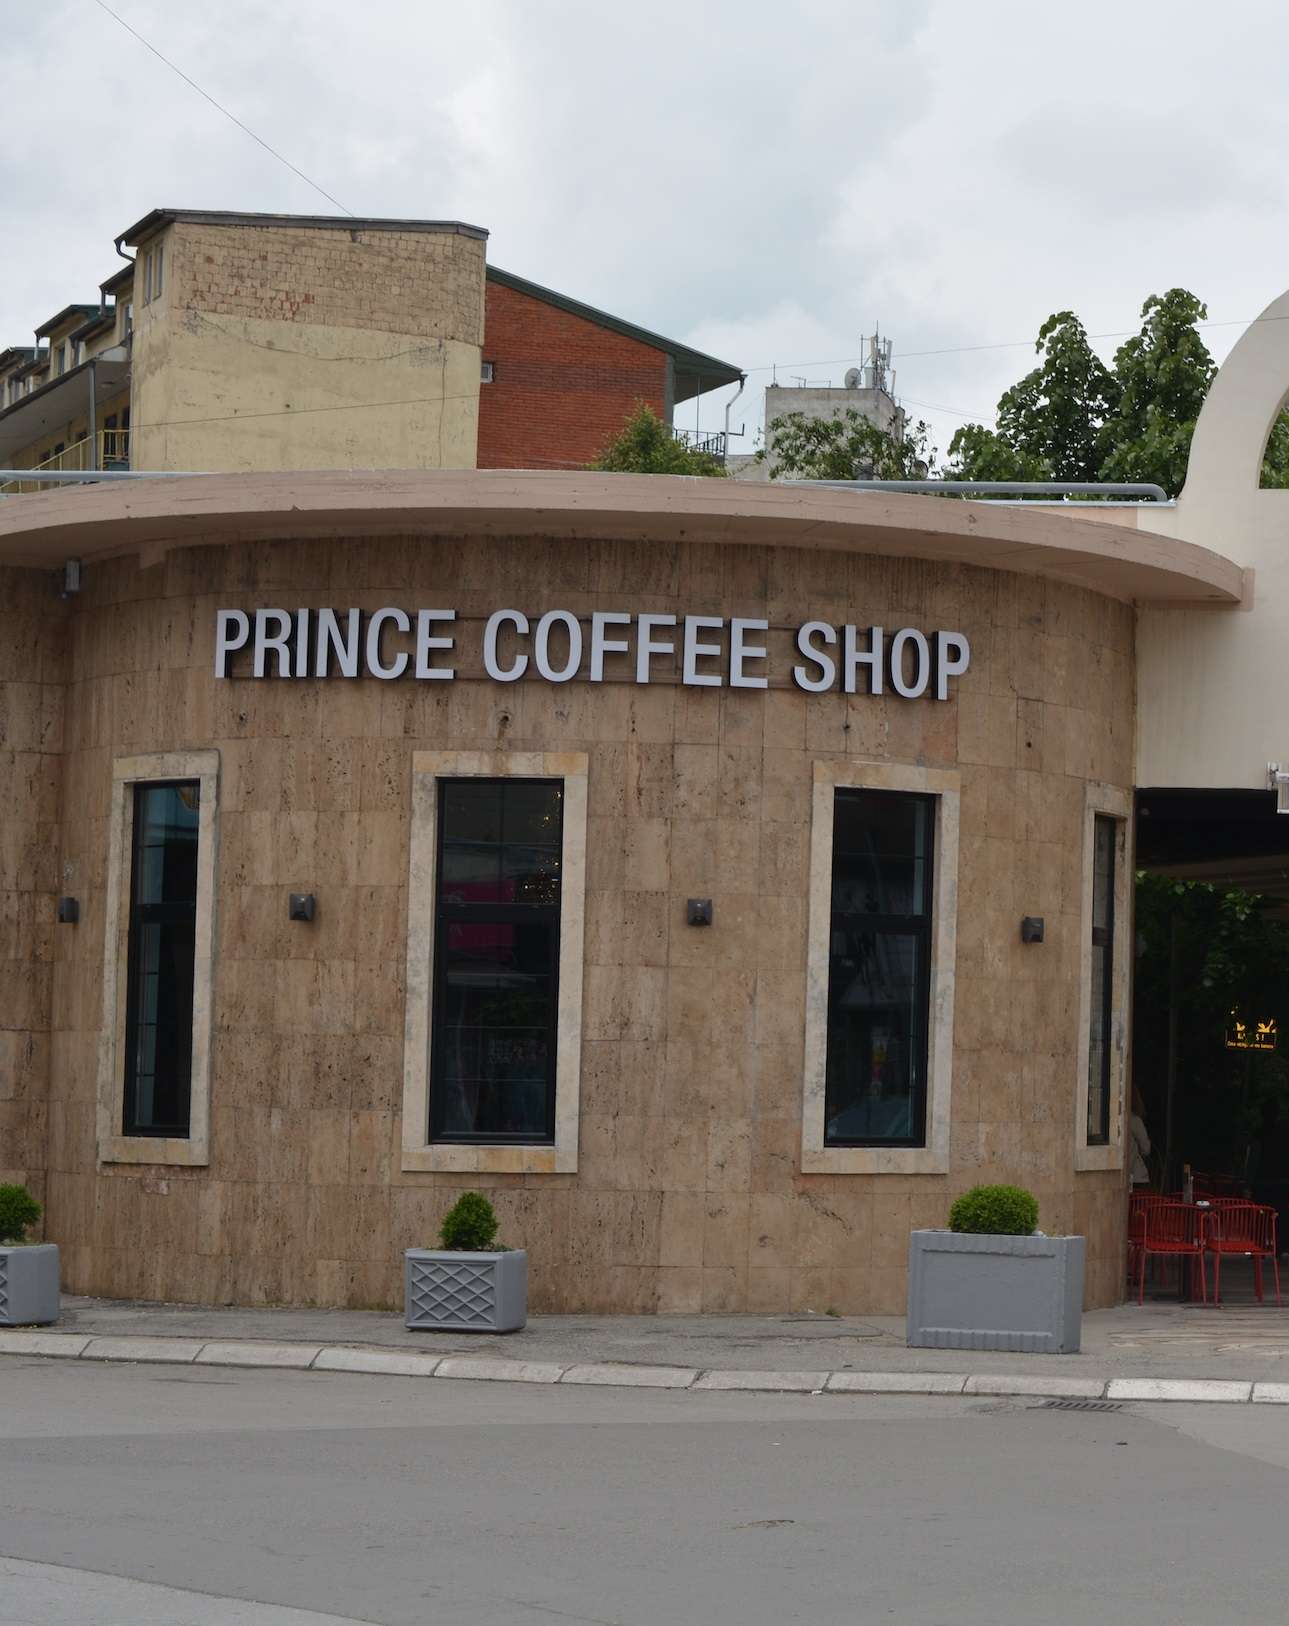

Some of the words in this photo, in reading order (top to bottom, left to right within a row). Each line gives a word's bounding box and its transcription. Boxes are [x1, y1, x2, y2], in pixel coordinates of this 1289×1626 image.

[214, 607, 456, 680] PRINCE
[483, 608, 769, 689] COFFEE
[792, 620, 971, 701] SHOP
